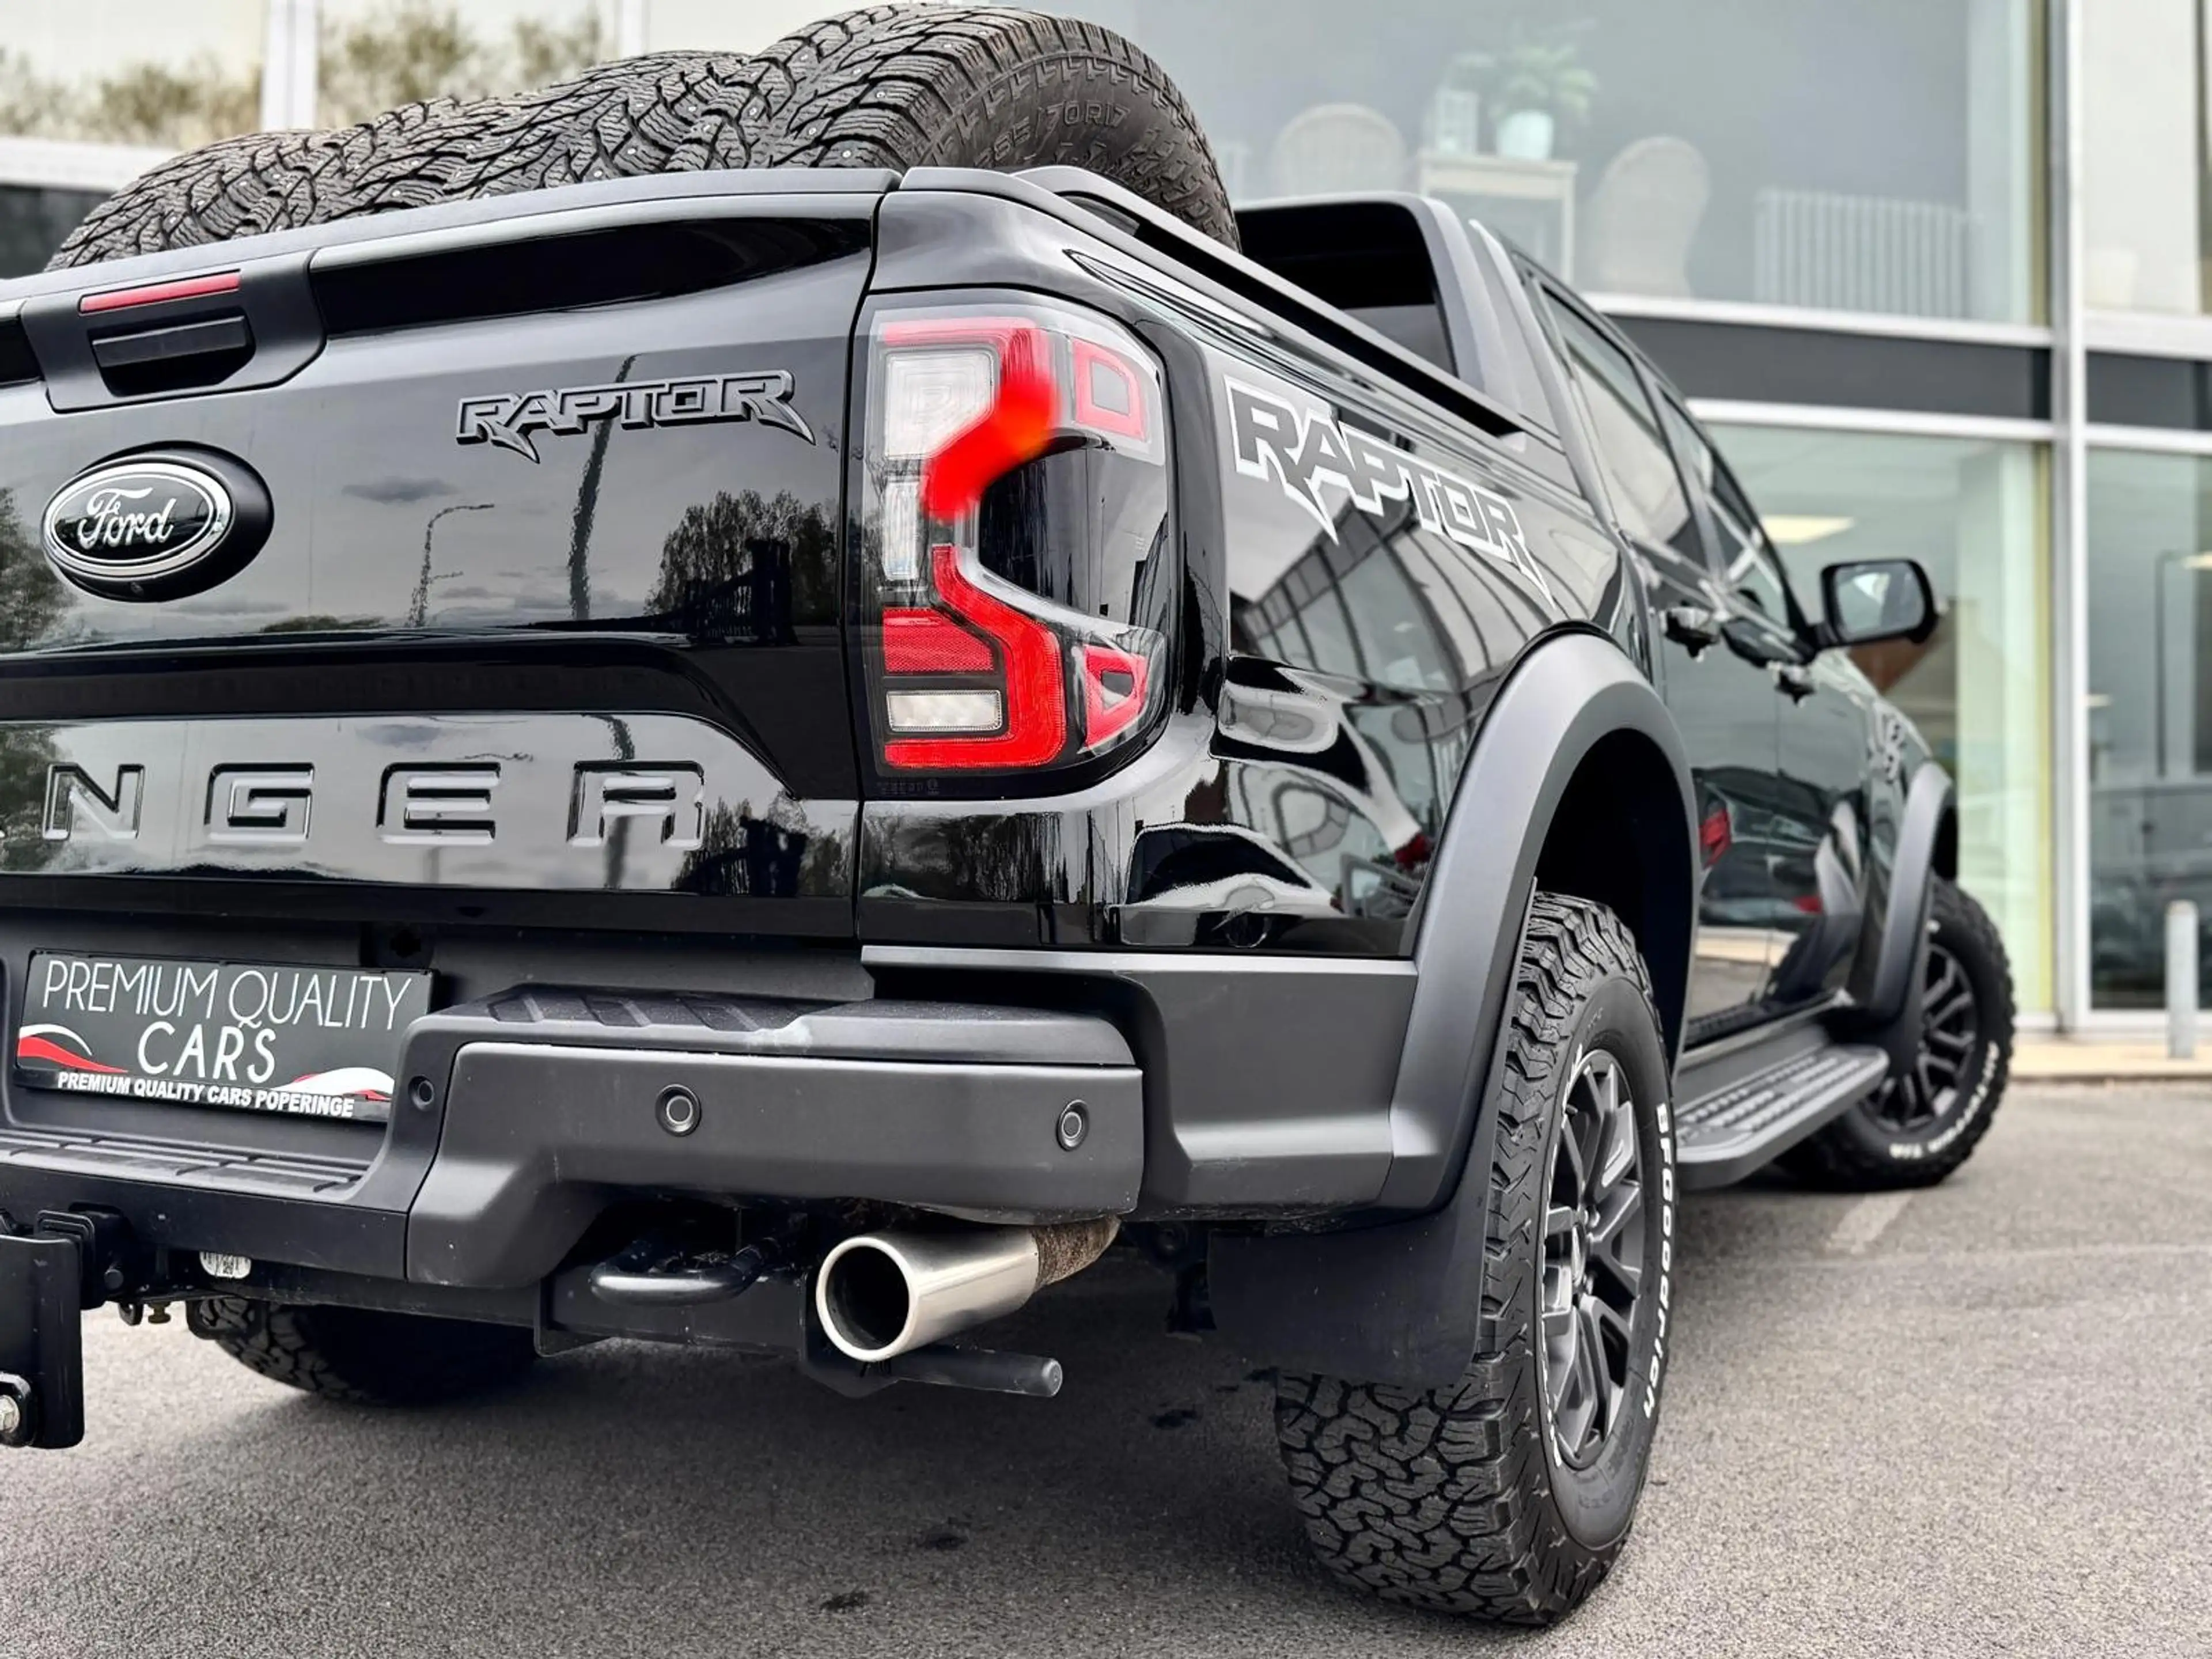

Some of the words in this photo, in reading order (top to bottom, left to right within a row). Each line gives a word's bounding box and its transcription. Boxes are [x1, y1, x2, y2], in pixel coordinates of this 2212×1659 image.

[456, 369, 816, 463] RAPTOR
[77, 487, 176, 549] Ford
[1224, 375, 1556, 608] RAPTOR
[42, 760, 704, 850] NGER
[43, 960, 219, 1019] PREMIUM
[229, 970, 411, 1030] QUALITY
[138, 1022, 276, 1084] CARS
[58, 1072, 131, 1094] PREMIUM
[134, 1080, 204, 1103] QUALITY
[207, 1089, 252, 1107] CARS
[255, 1092, 355, 1118] POPERINGE
